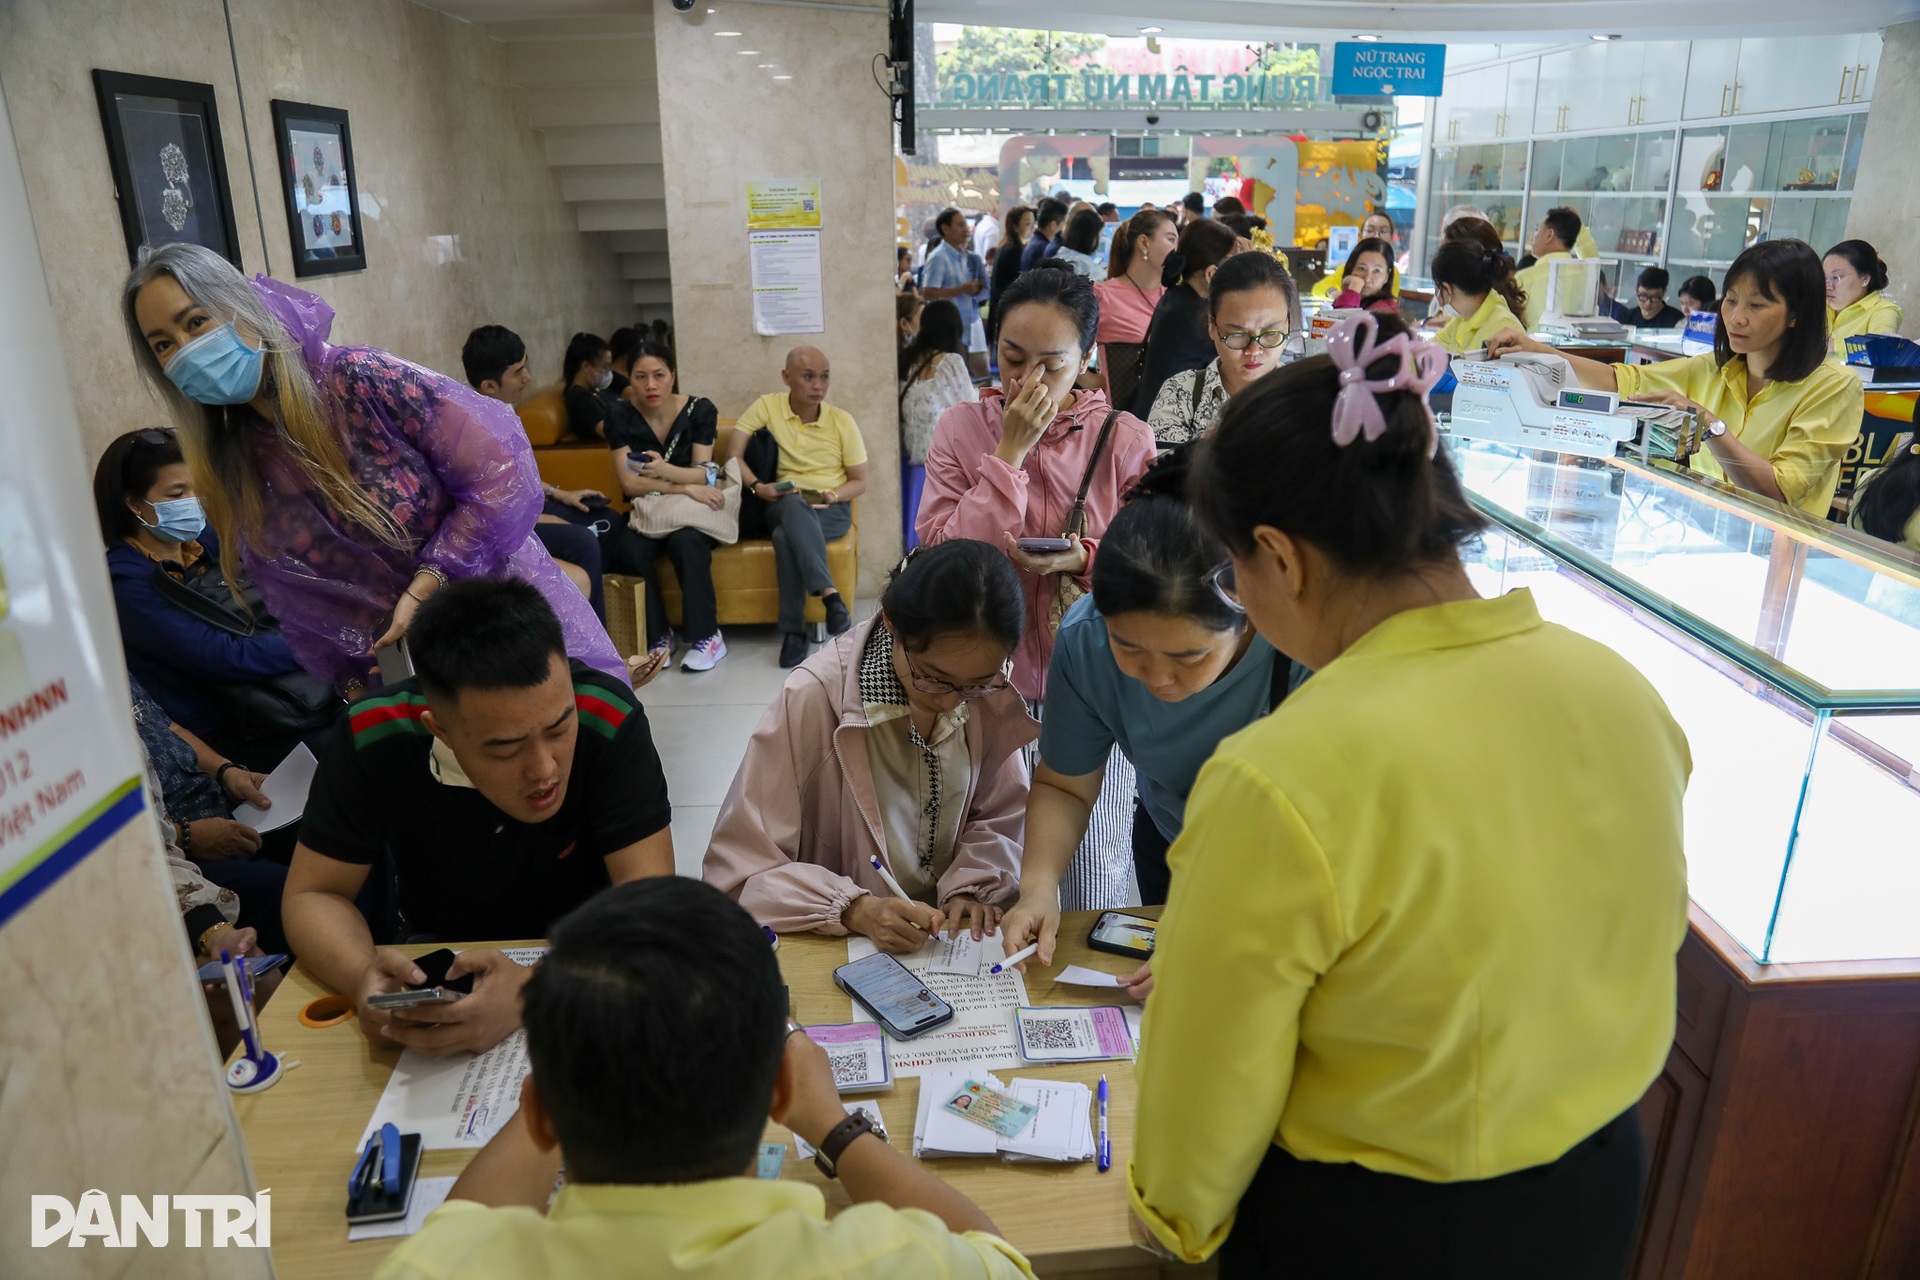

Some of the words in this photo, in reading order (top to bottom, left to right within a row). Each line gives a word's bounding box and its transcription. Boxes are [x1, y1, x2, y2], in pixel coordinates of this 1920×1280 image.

[1355, 49, 1378, 64] NỮ
[1380, 51, 1426, 64] TRANG
[1352, 66, 1394, 80] NGỌC
[1396, 67, 1426, 79] TRAI
[35, 769, 86, 817] Nam
[912, 1050, 946, 1058] MOMO,
[894, 1058, 933, 1068] CHÍNH
